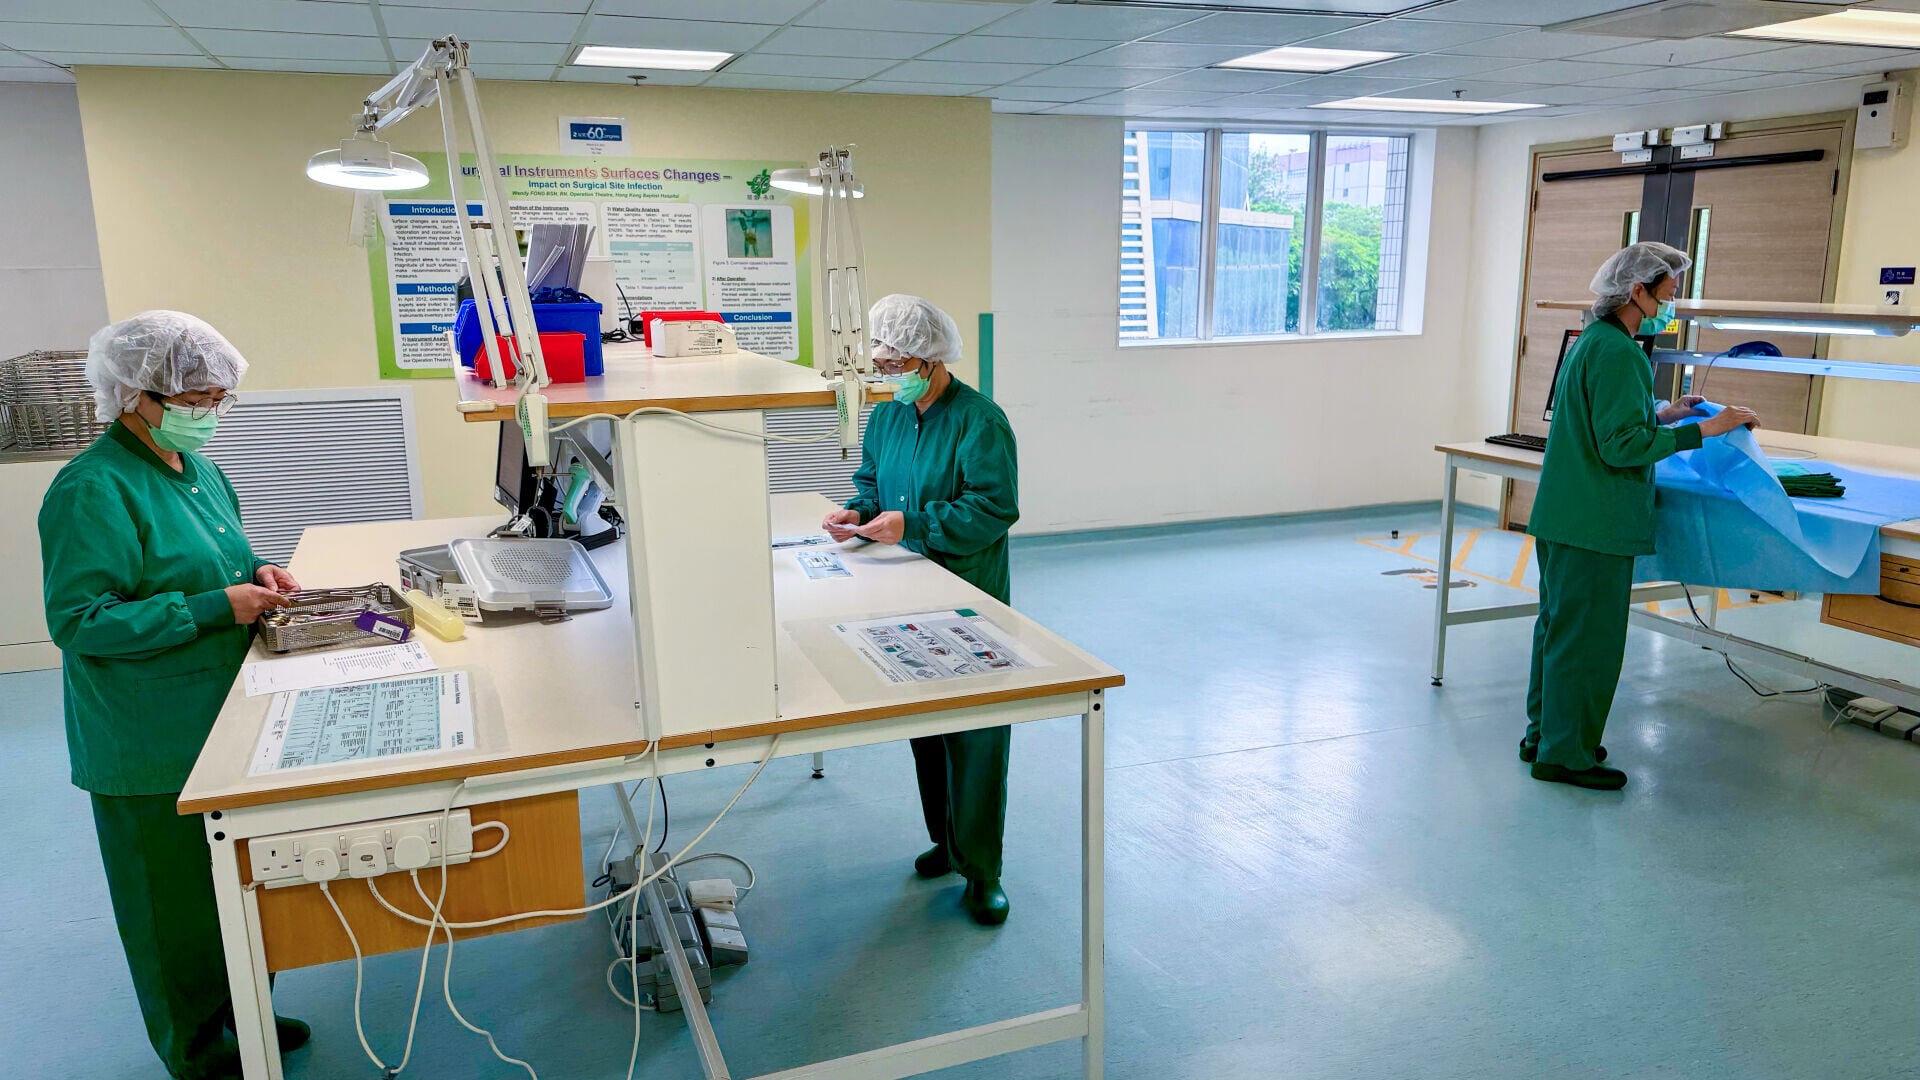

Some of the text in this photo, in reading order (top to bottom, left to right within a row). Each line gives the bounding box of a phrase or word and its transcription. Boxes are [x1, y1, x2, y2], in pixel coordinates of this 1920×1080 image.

[515, 166, 597, 178] Instruments
[601, 166, 659, 179] Surfaces
[664, 168, 720, 183] Changes
[528, 180, 557, 189] Impact
[573, 181, 607, 190] Surgical
[609, 182, 625, 190] Site
[627, 182, 663, 190] Infection
